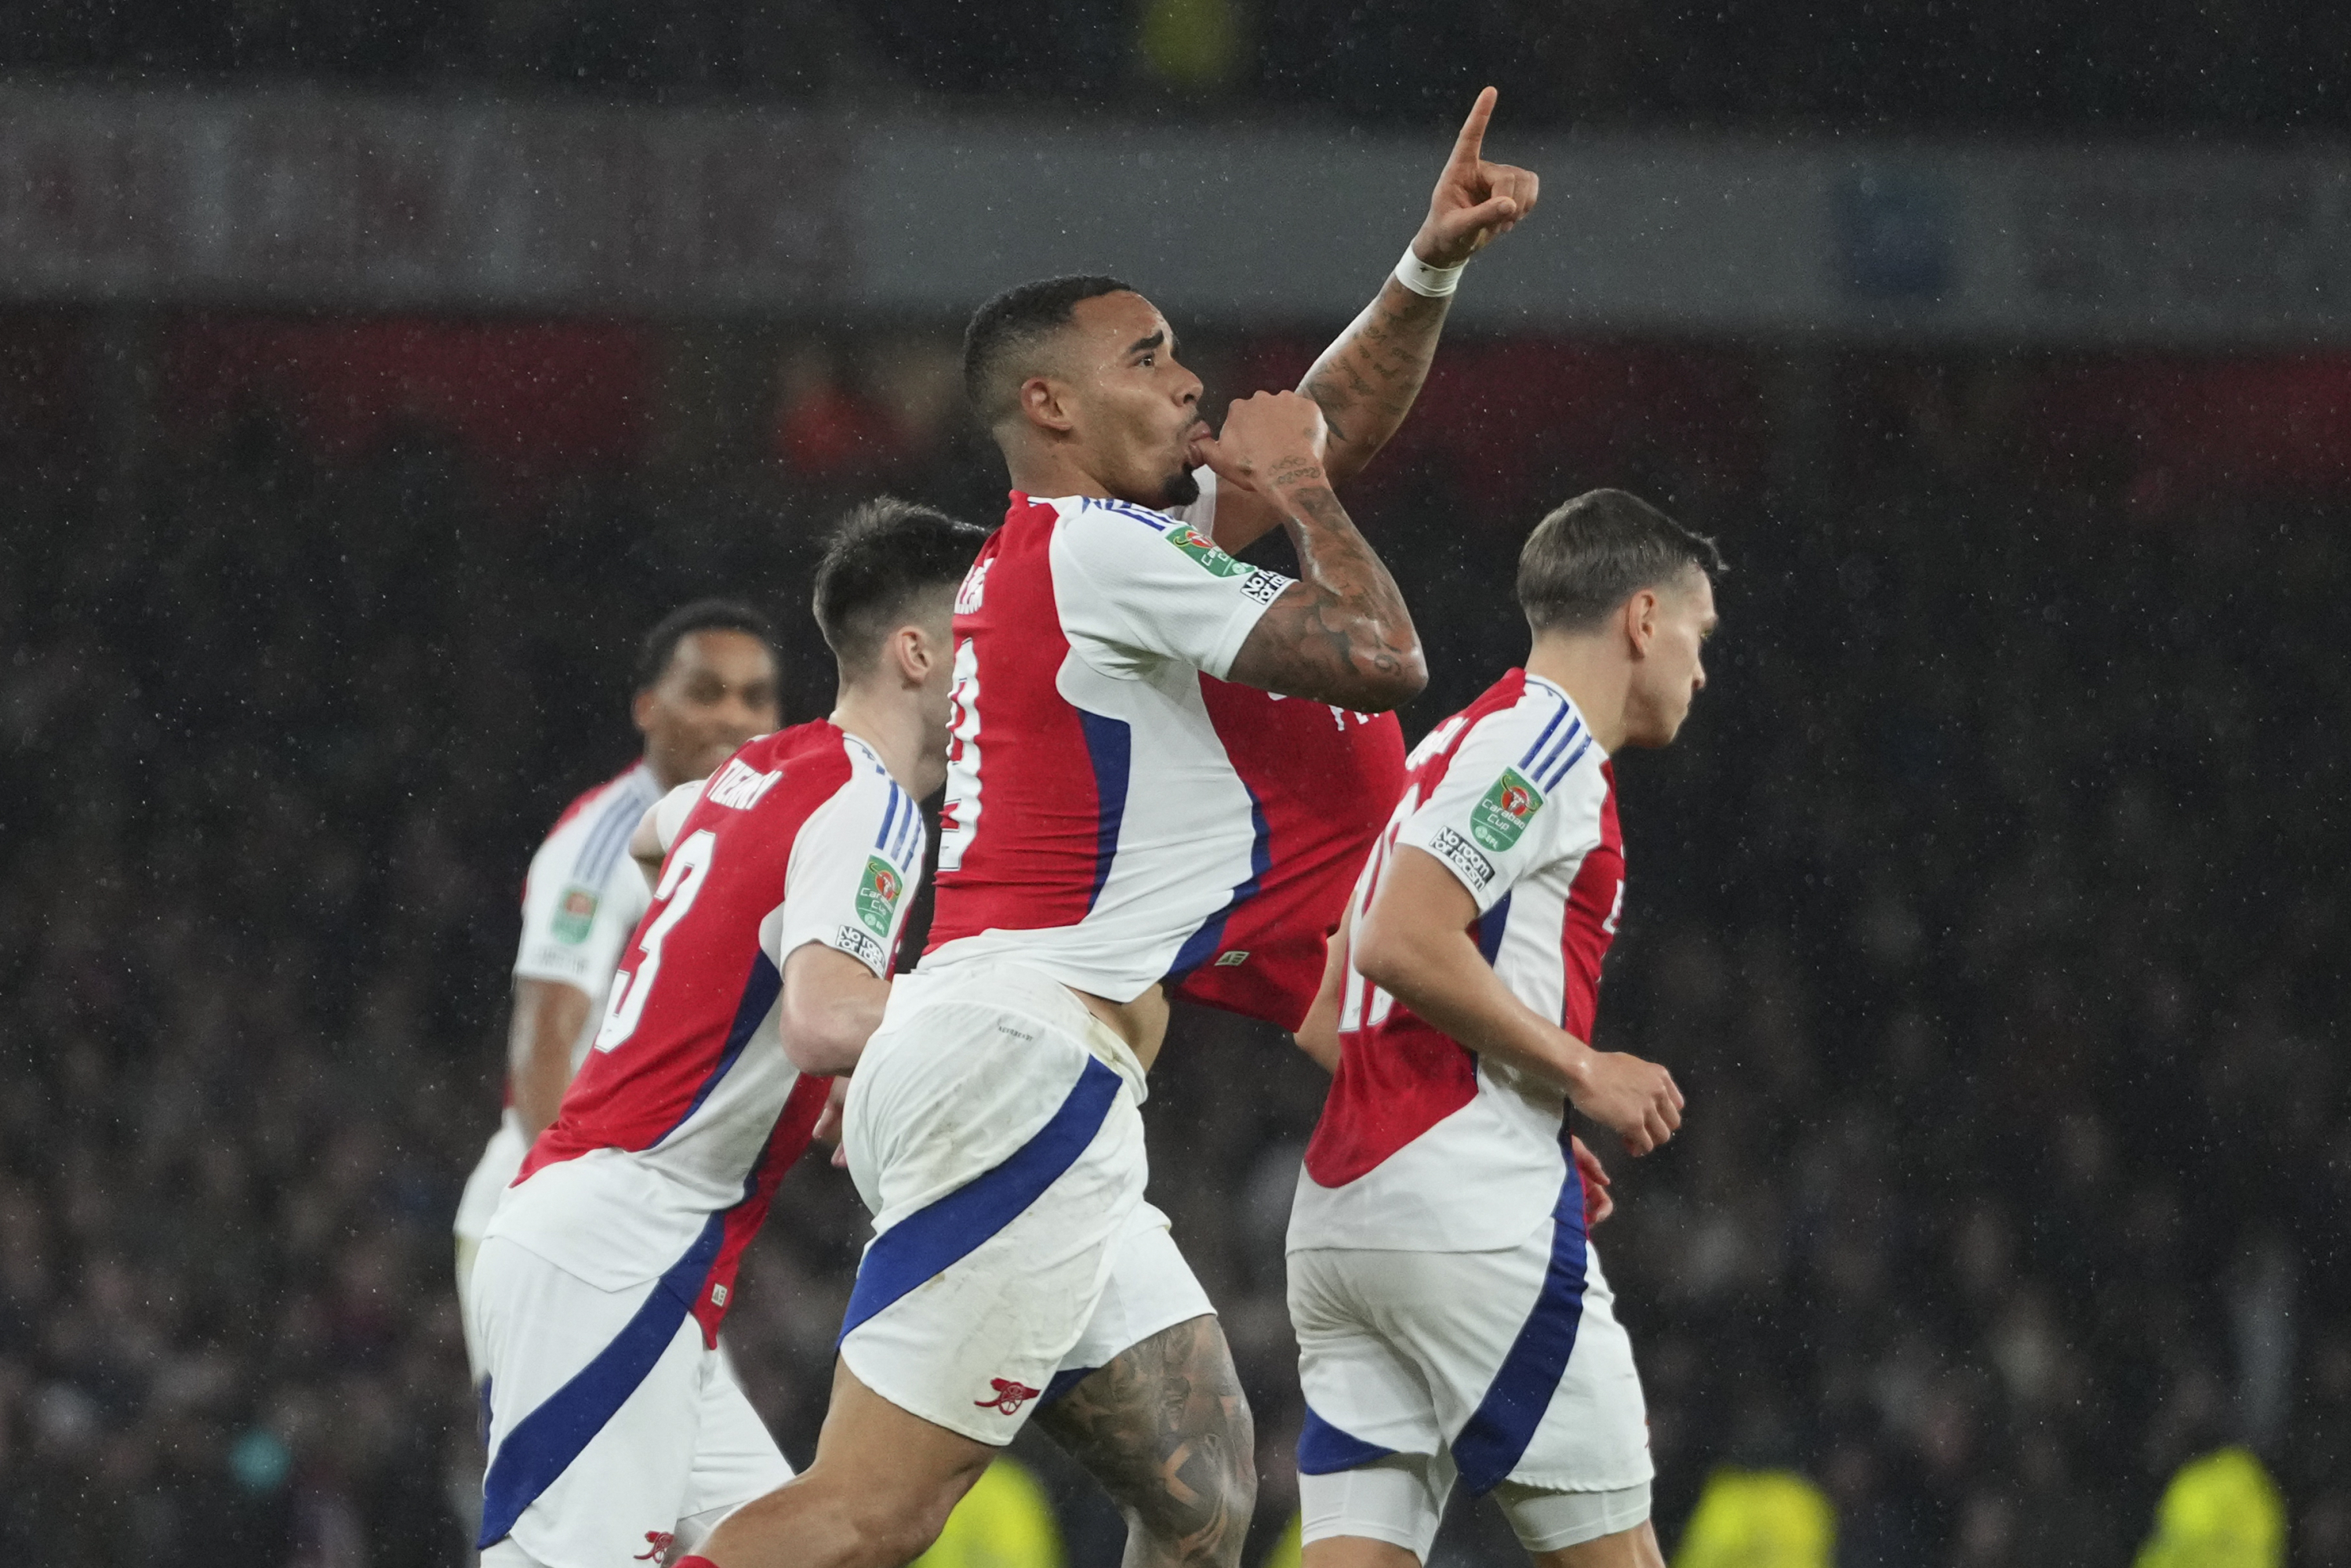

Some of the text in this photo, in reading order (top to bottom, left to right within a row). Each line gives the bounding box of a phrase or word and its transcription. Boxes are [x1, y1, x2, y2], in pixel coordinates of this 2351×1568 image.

[1241, 576, 1265, 597] No
[1482, 798, 1526, 830] Carabao
[1487, 813, 1510, 831] Cup
[1429, 837, 1486, 893] for racism
[1436, 826, 1490, 878] No room
[594, 829, 717, 1053] 3
[836, 936, 859, 951] for
[839, 925, 861, 942] No
